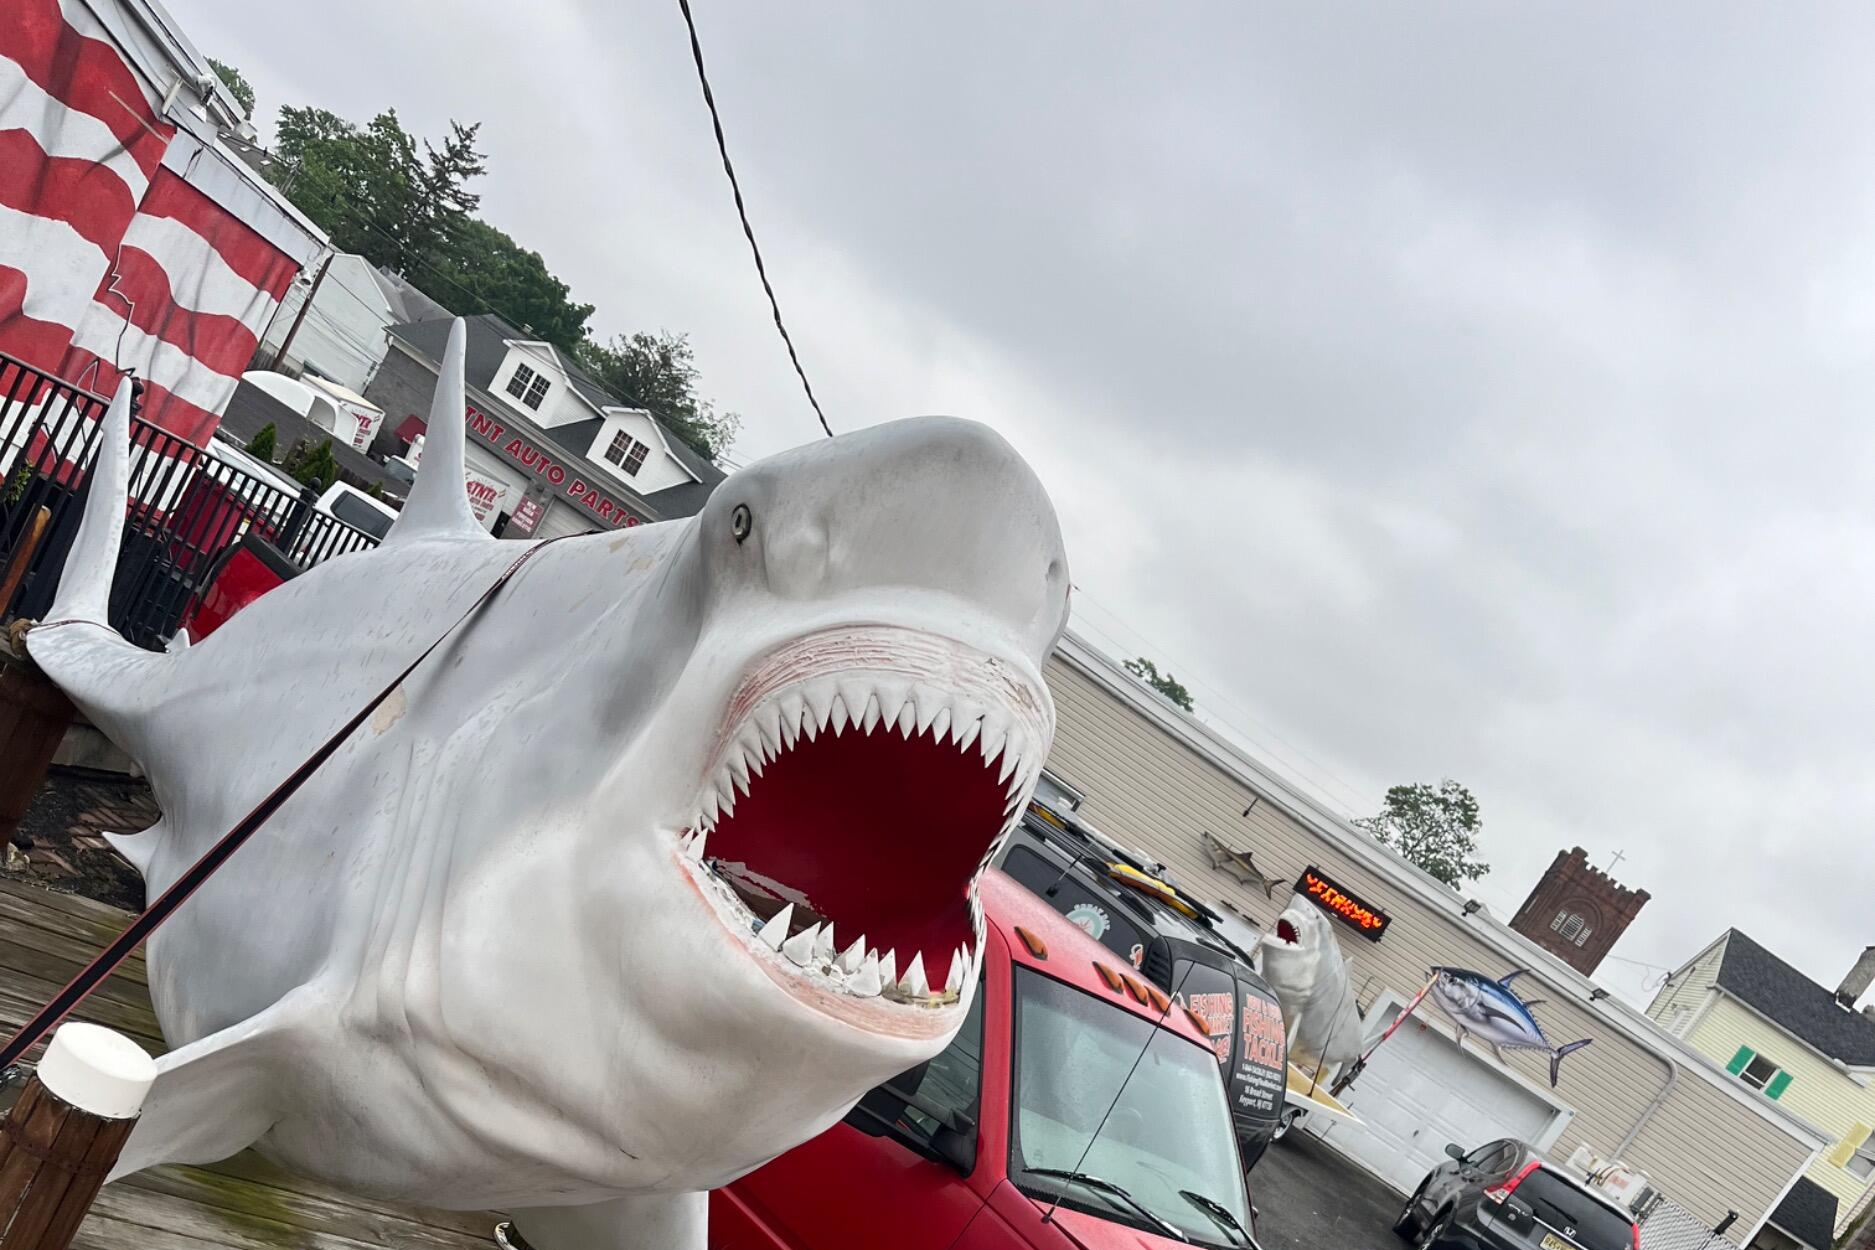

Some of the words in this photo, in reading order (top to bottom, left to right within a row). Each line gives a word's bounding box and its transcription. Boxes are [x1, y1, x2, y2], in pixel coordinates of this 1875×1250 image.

[465, 406, 506, 443] TNT
[504, 439, 567, 486] AUTO
[566, 479, 642, 529] PARTS
[1190, 992, 1234, 1020] FISHING
[1243, 1006, 1285, 1047] FISHING
[1244, 1033, 1284, 1071] TACKLE
